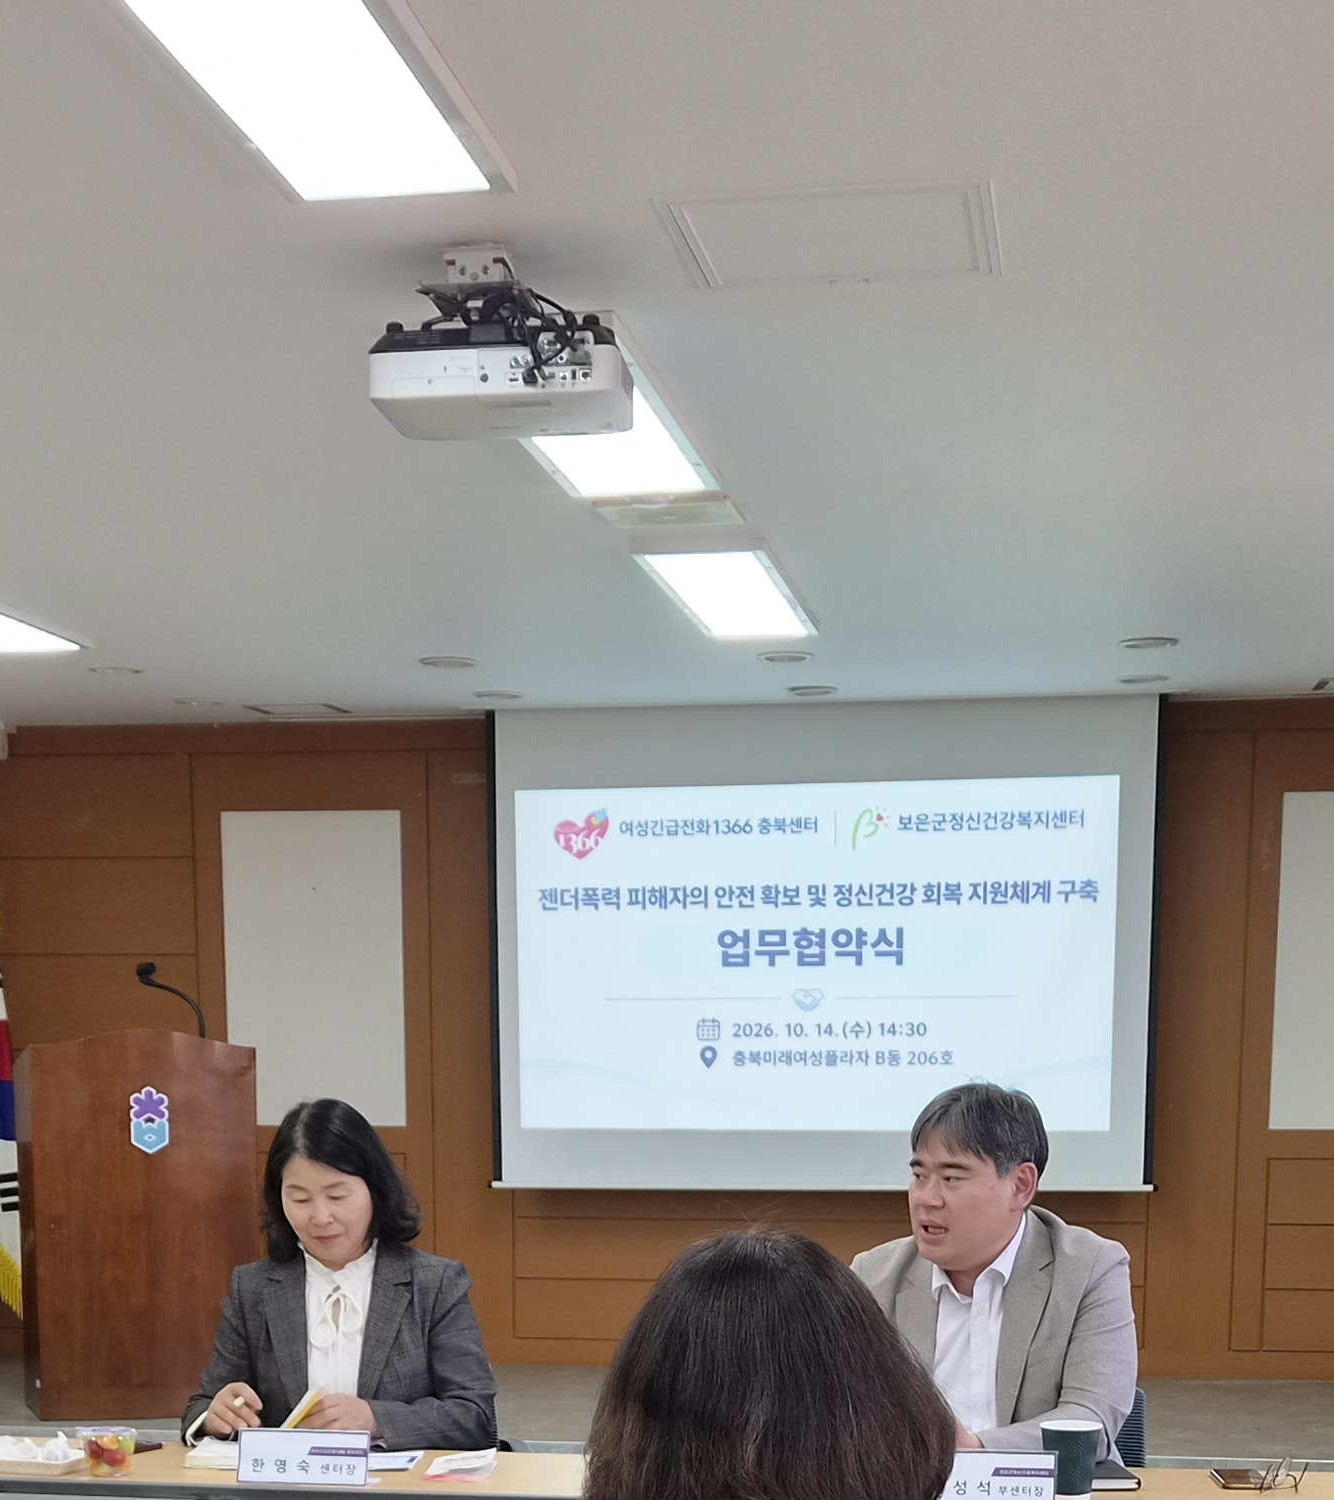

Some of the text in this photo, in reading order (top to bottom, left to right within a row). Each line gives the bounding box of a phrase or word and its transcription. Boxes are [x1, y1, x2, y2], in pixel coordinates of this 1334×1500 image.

[619, 816, 818, 837] 여성긴급전화1366 충북센터
[897, 809, 1085, 832] 보은군정신건강복지센터
[557, 829, 602, 855] 1366
[538, 878, 1100, 911] 젠더폭력 피해자의 안전 확보 및 정신건강 회복 지원체계 구축
[717, 927, 904, 967] 업무협약식
[732, 1022, 778, 1038] 2026.
[785, 1022, 808, 1037] 10.
[879, 1022, 927, 1037] 14:30
[732, 1050, 954, 1067] 충북미래여성플라자 B동 206호
[319, 1463, 357, 1475] 센터장
[998, 1485, 1044, 1497] 부센터장
